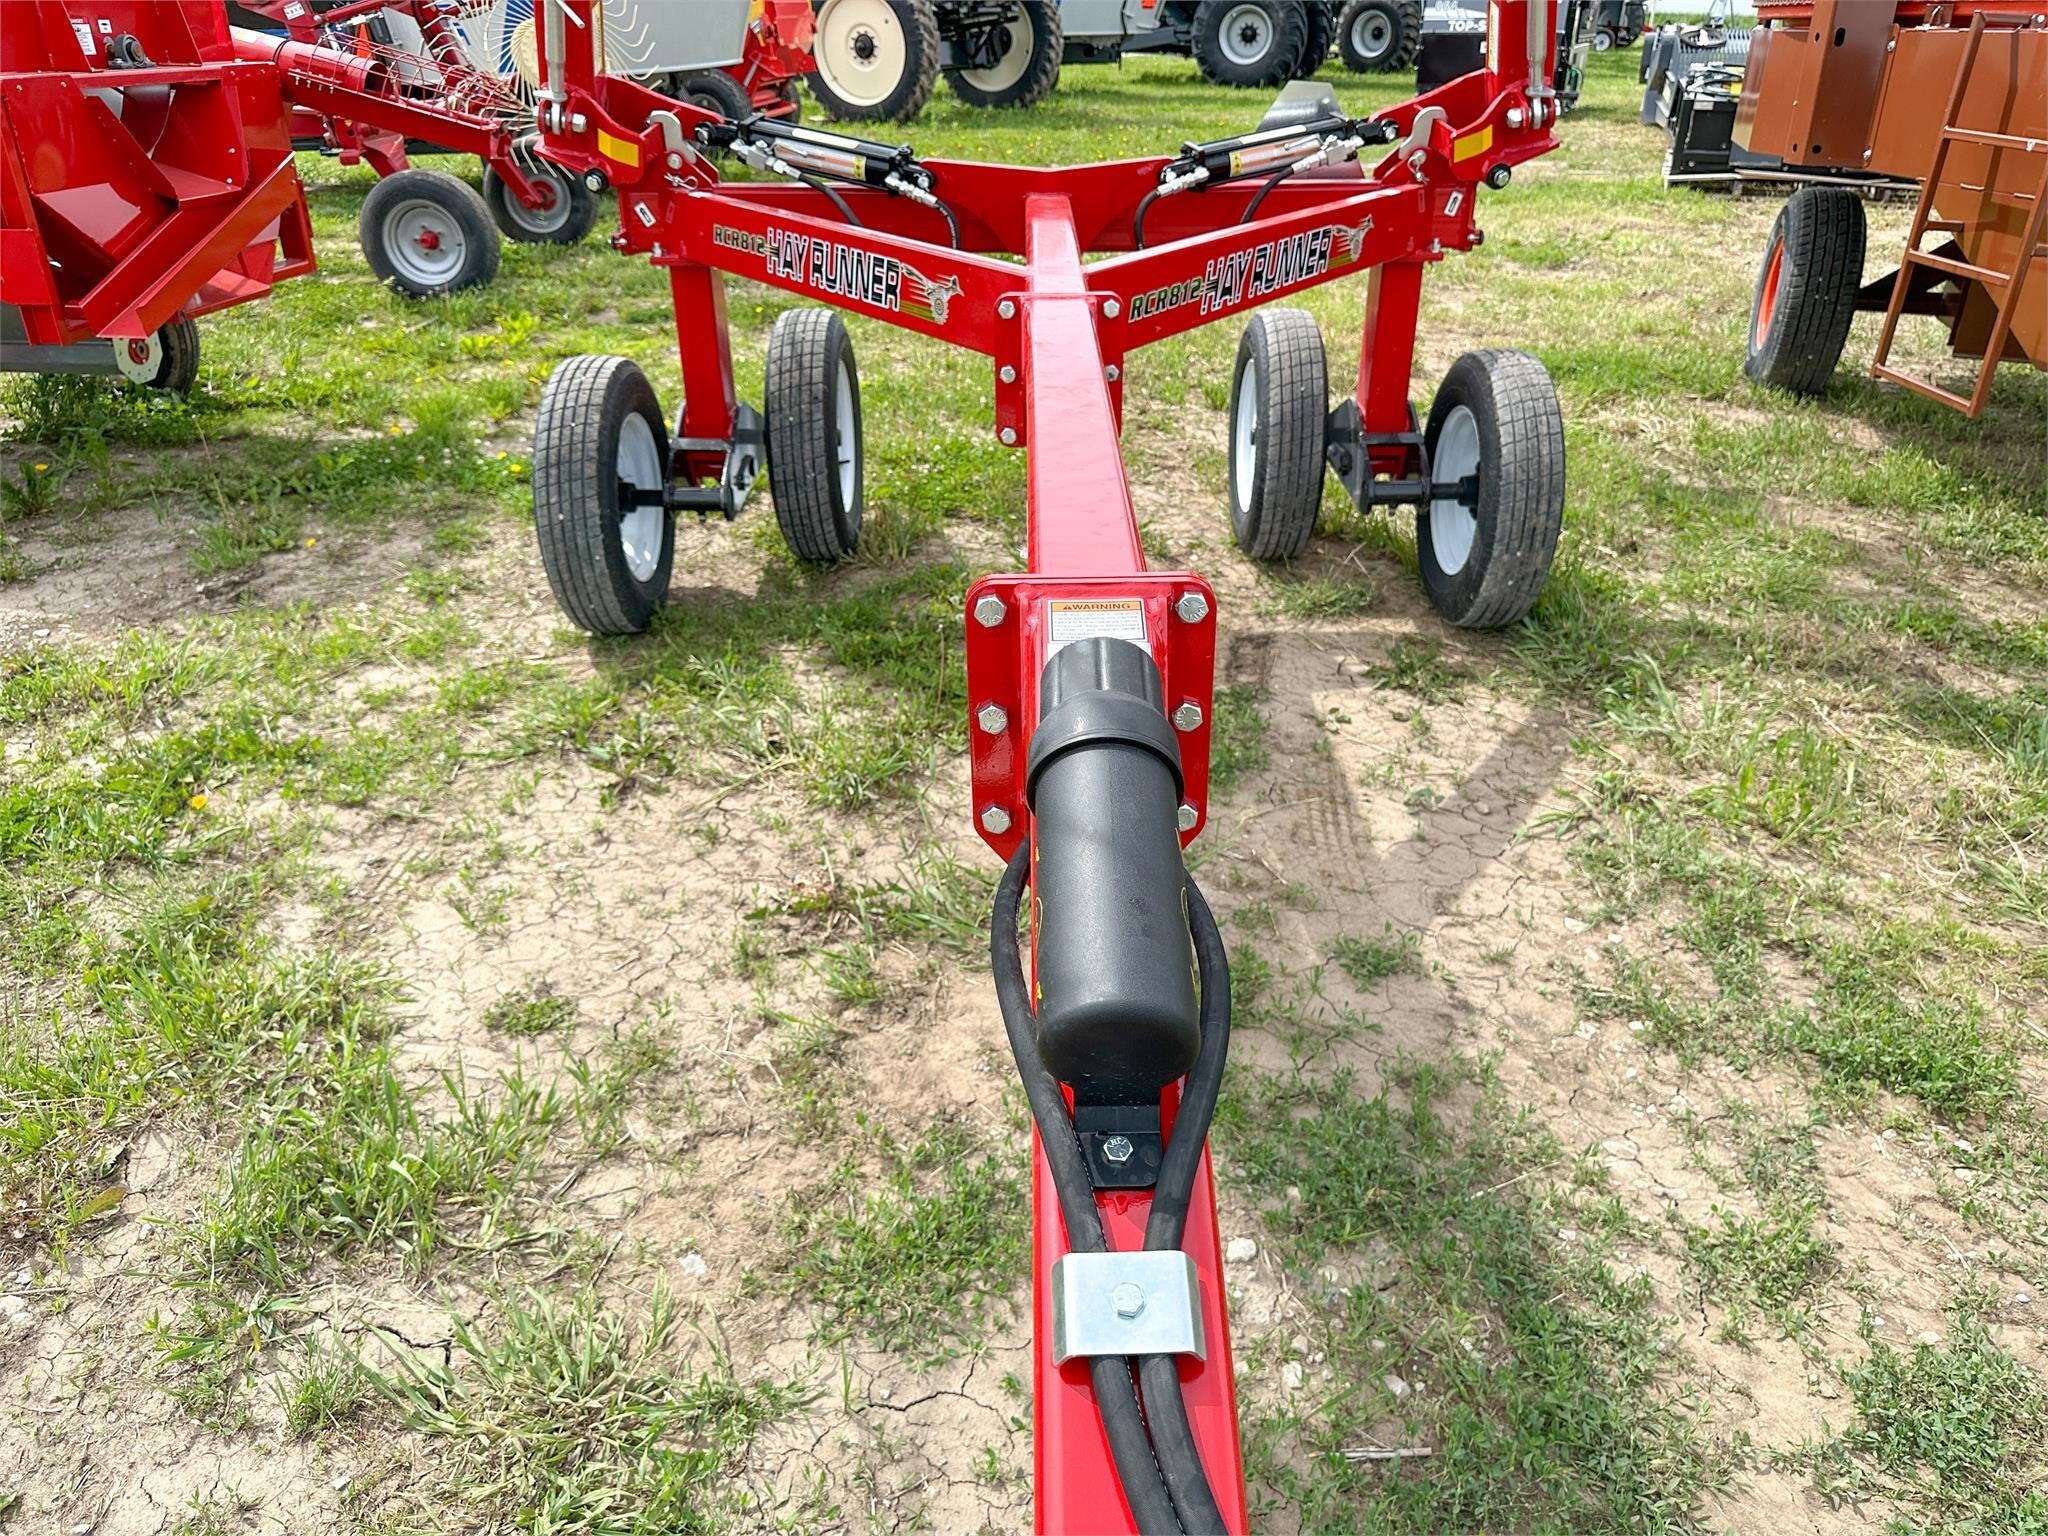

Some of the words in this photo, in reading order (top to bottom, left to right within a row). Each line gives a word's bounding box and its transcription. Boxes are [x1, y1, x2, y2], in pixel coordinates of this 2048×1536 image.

[714, 224, 767, 256] RCR812
[766, 226, 809, 284] HAY
[809, 240, 901, 312] RUNNER
[1128, 276, 1202, 323] RCR812
[1200, 248, 1253, 316] HAY
[1248, 225, 1333, 298] RUNNER
